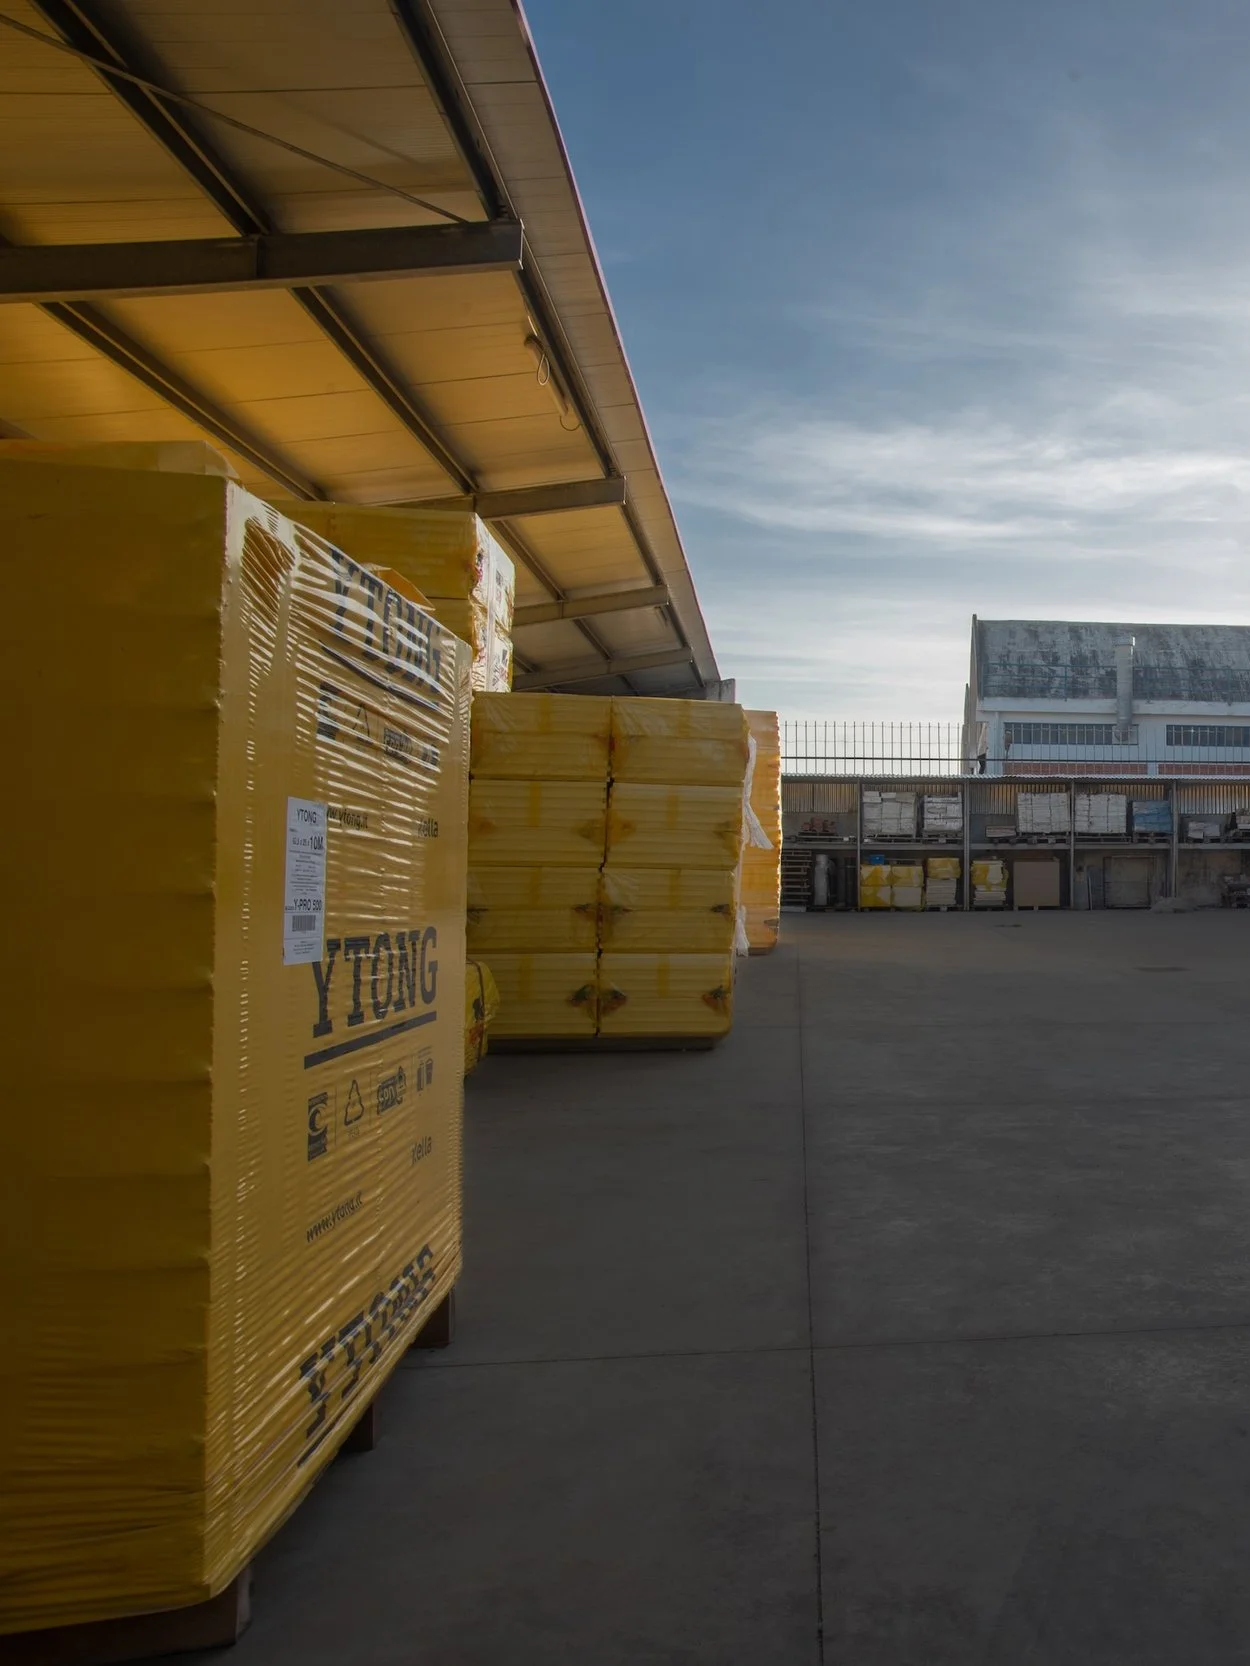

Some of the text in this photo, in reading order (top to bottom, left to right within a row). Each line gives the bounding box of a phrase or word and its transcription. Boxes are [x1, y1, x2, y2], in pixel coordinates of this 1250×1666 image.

[329, 549, 440, 693] YTONG
[297, 808, 317, 823] YTONG
[312, 926, 438, 1038] YTONG
[306, 1190, 362, 1244] www.ytong.it
